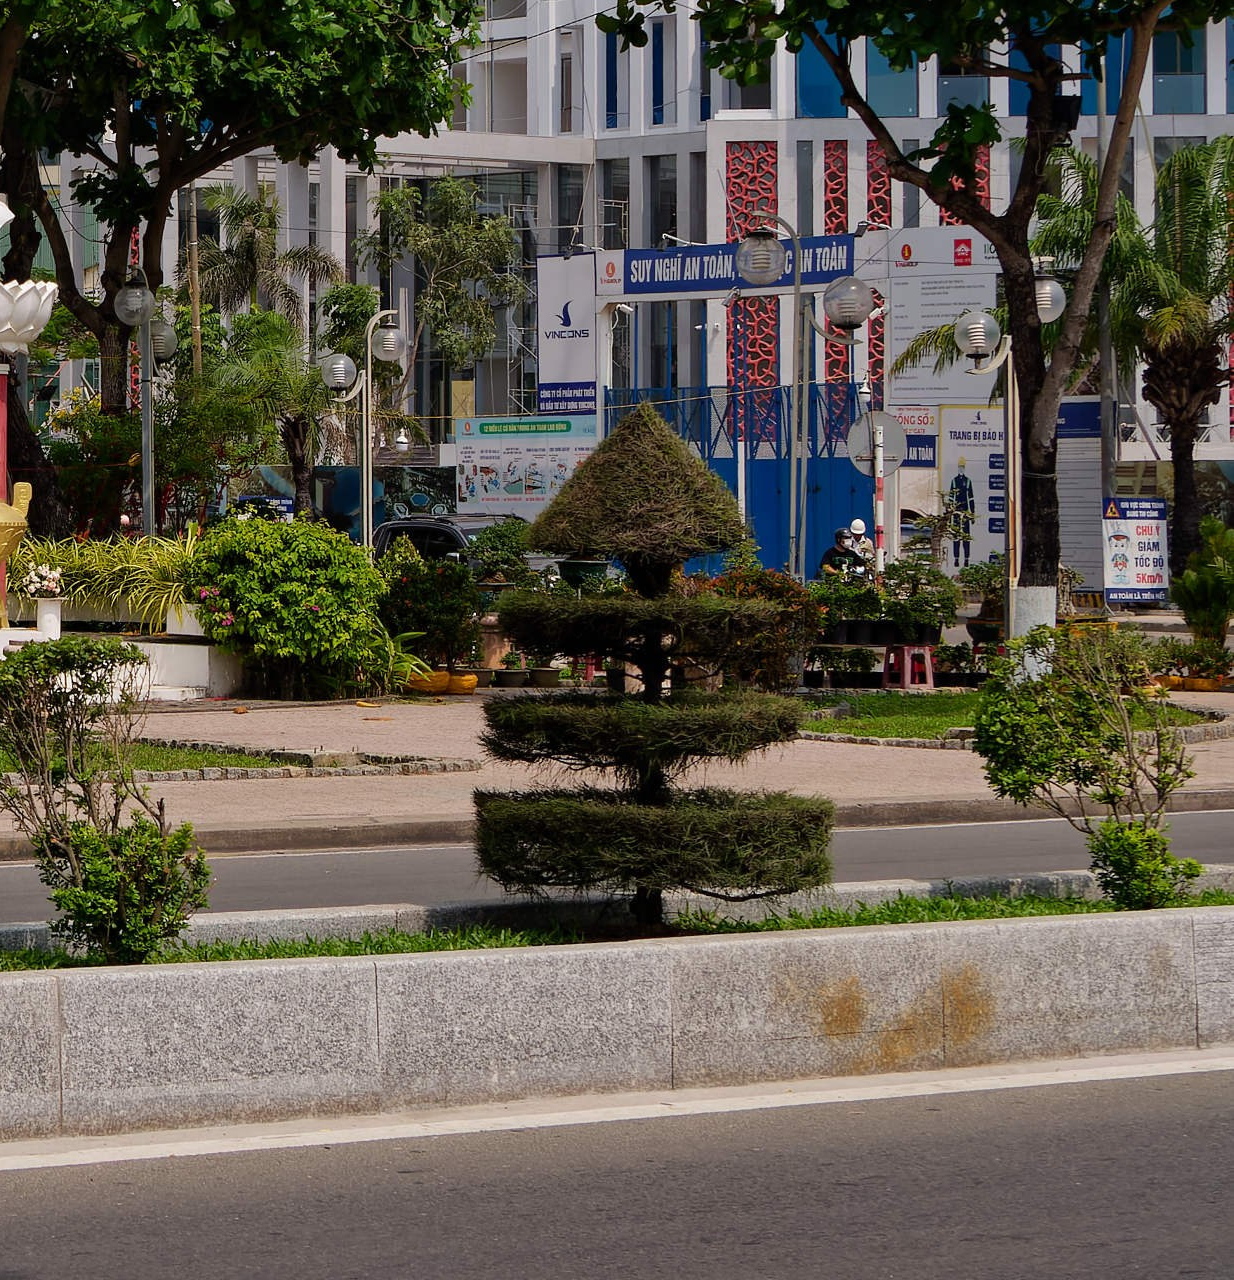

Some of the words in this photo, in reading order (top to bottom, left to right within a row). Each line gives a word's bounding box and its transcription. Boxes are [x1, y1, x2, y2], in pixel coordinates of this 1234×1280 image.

[630, 259, 652, 283] SUY
[655, 253, 681, 282] NGHĨ
[684, 256, 700, 281] AN
[816, 242, 847, 272] TOÀN
[544, 329, 590, 339] VINCONS
[930, 416, 935, 425] 2
[949, 431, 972, 440] TRANG
[1137, 539, 1160, 551] GIẢM
[1134, 554, 1150, 567] TỐC
[1152, 555, 1164, 570] ĐỘ
[1136, 572, 1163, 584] 5Km/h
